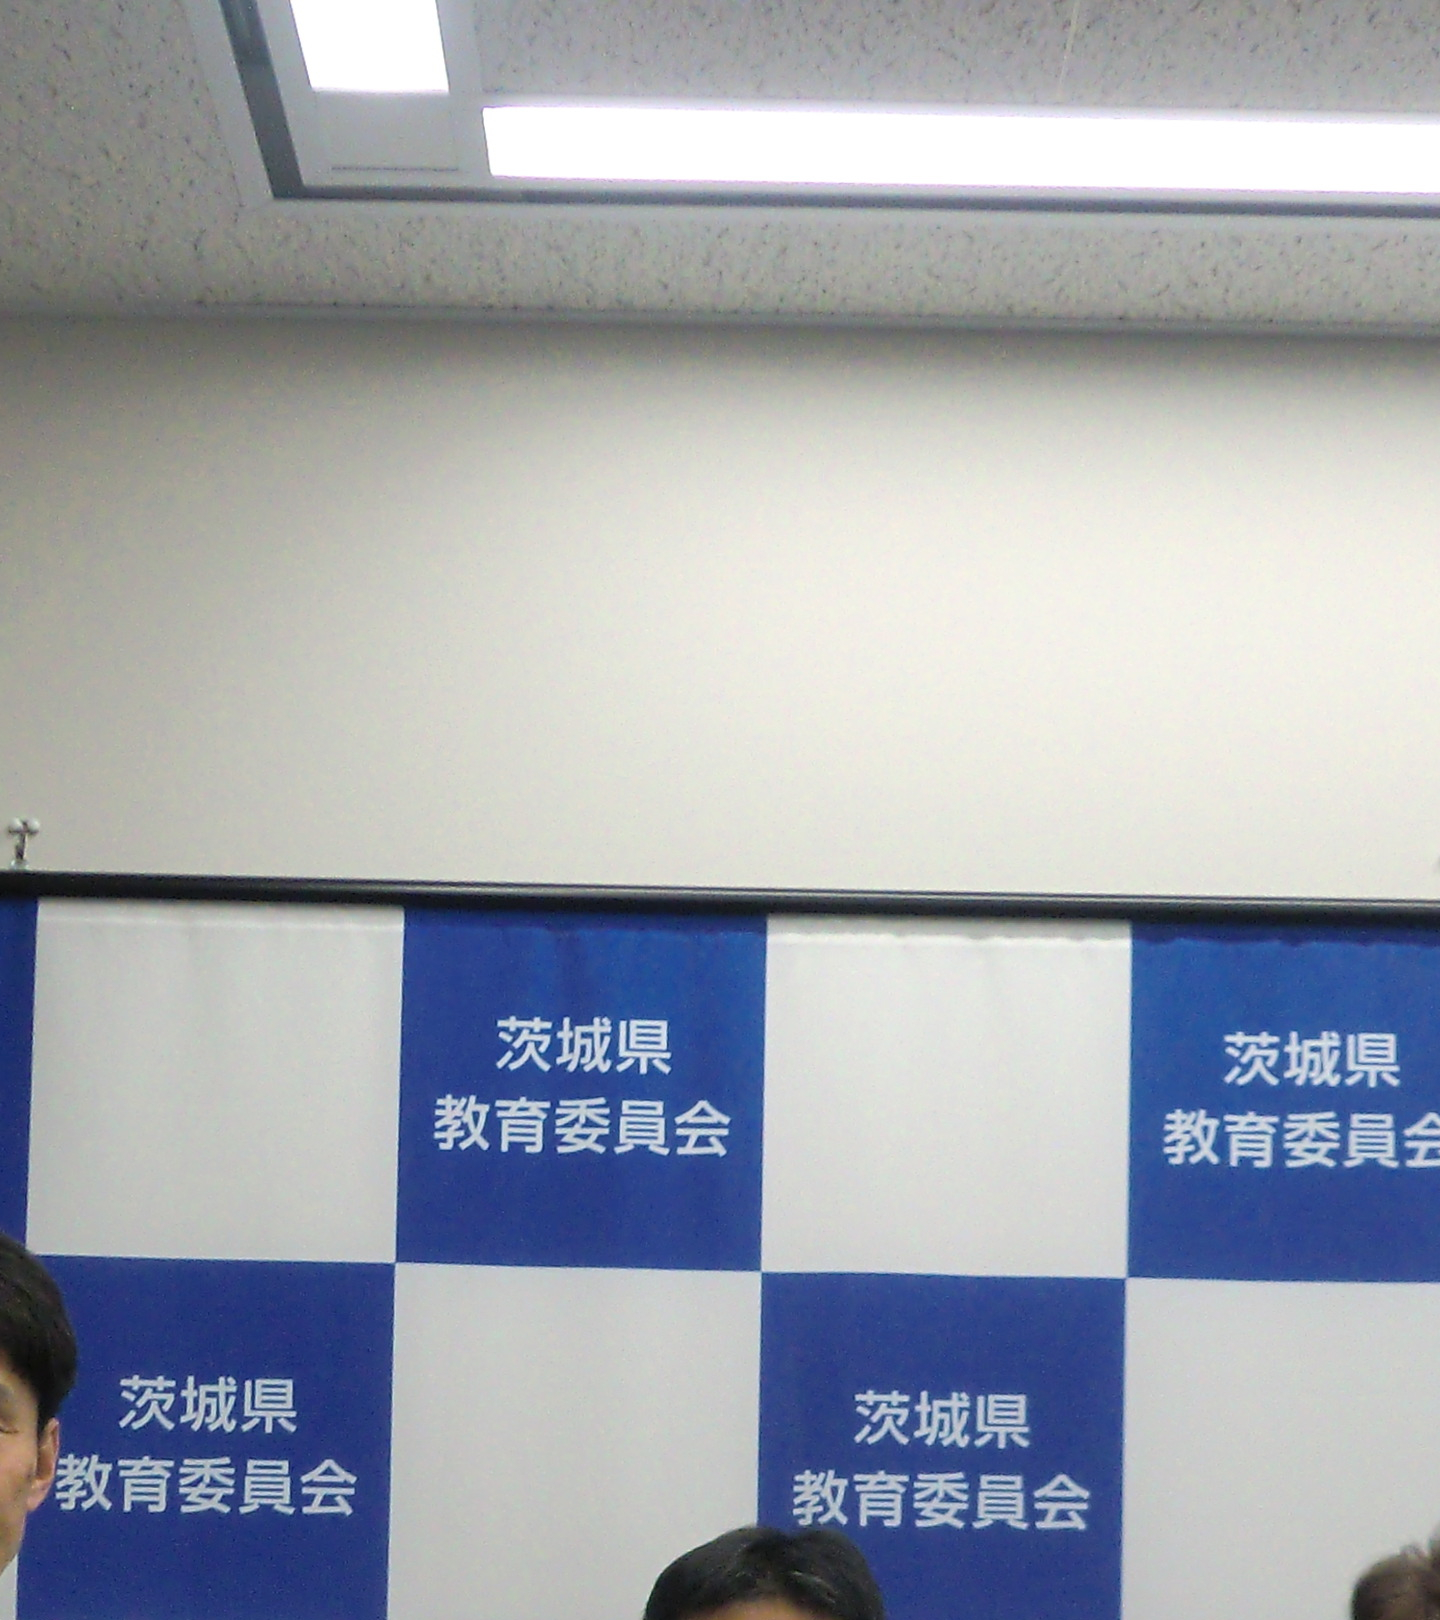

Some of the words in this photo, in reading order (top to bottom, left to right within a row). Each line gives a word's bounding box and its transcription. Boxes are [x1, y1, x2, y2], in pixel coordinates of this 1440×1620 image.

[497, 1016, 672, 1075] 茨城県
[1224, 1031, 1400, 1088] 茨城県
[433, 1094, 731, 1157] 教育委員会
[119, 1374, 298, 1434] 茨城県
[854, 1389, 1030, 1449] 茨城県
[55, 1454, 358, 1516] 教育委員会
[792, 1469, 1090, 1530] 教育委員会
